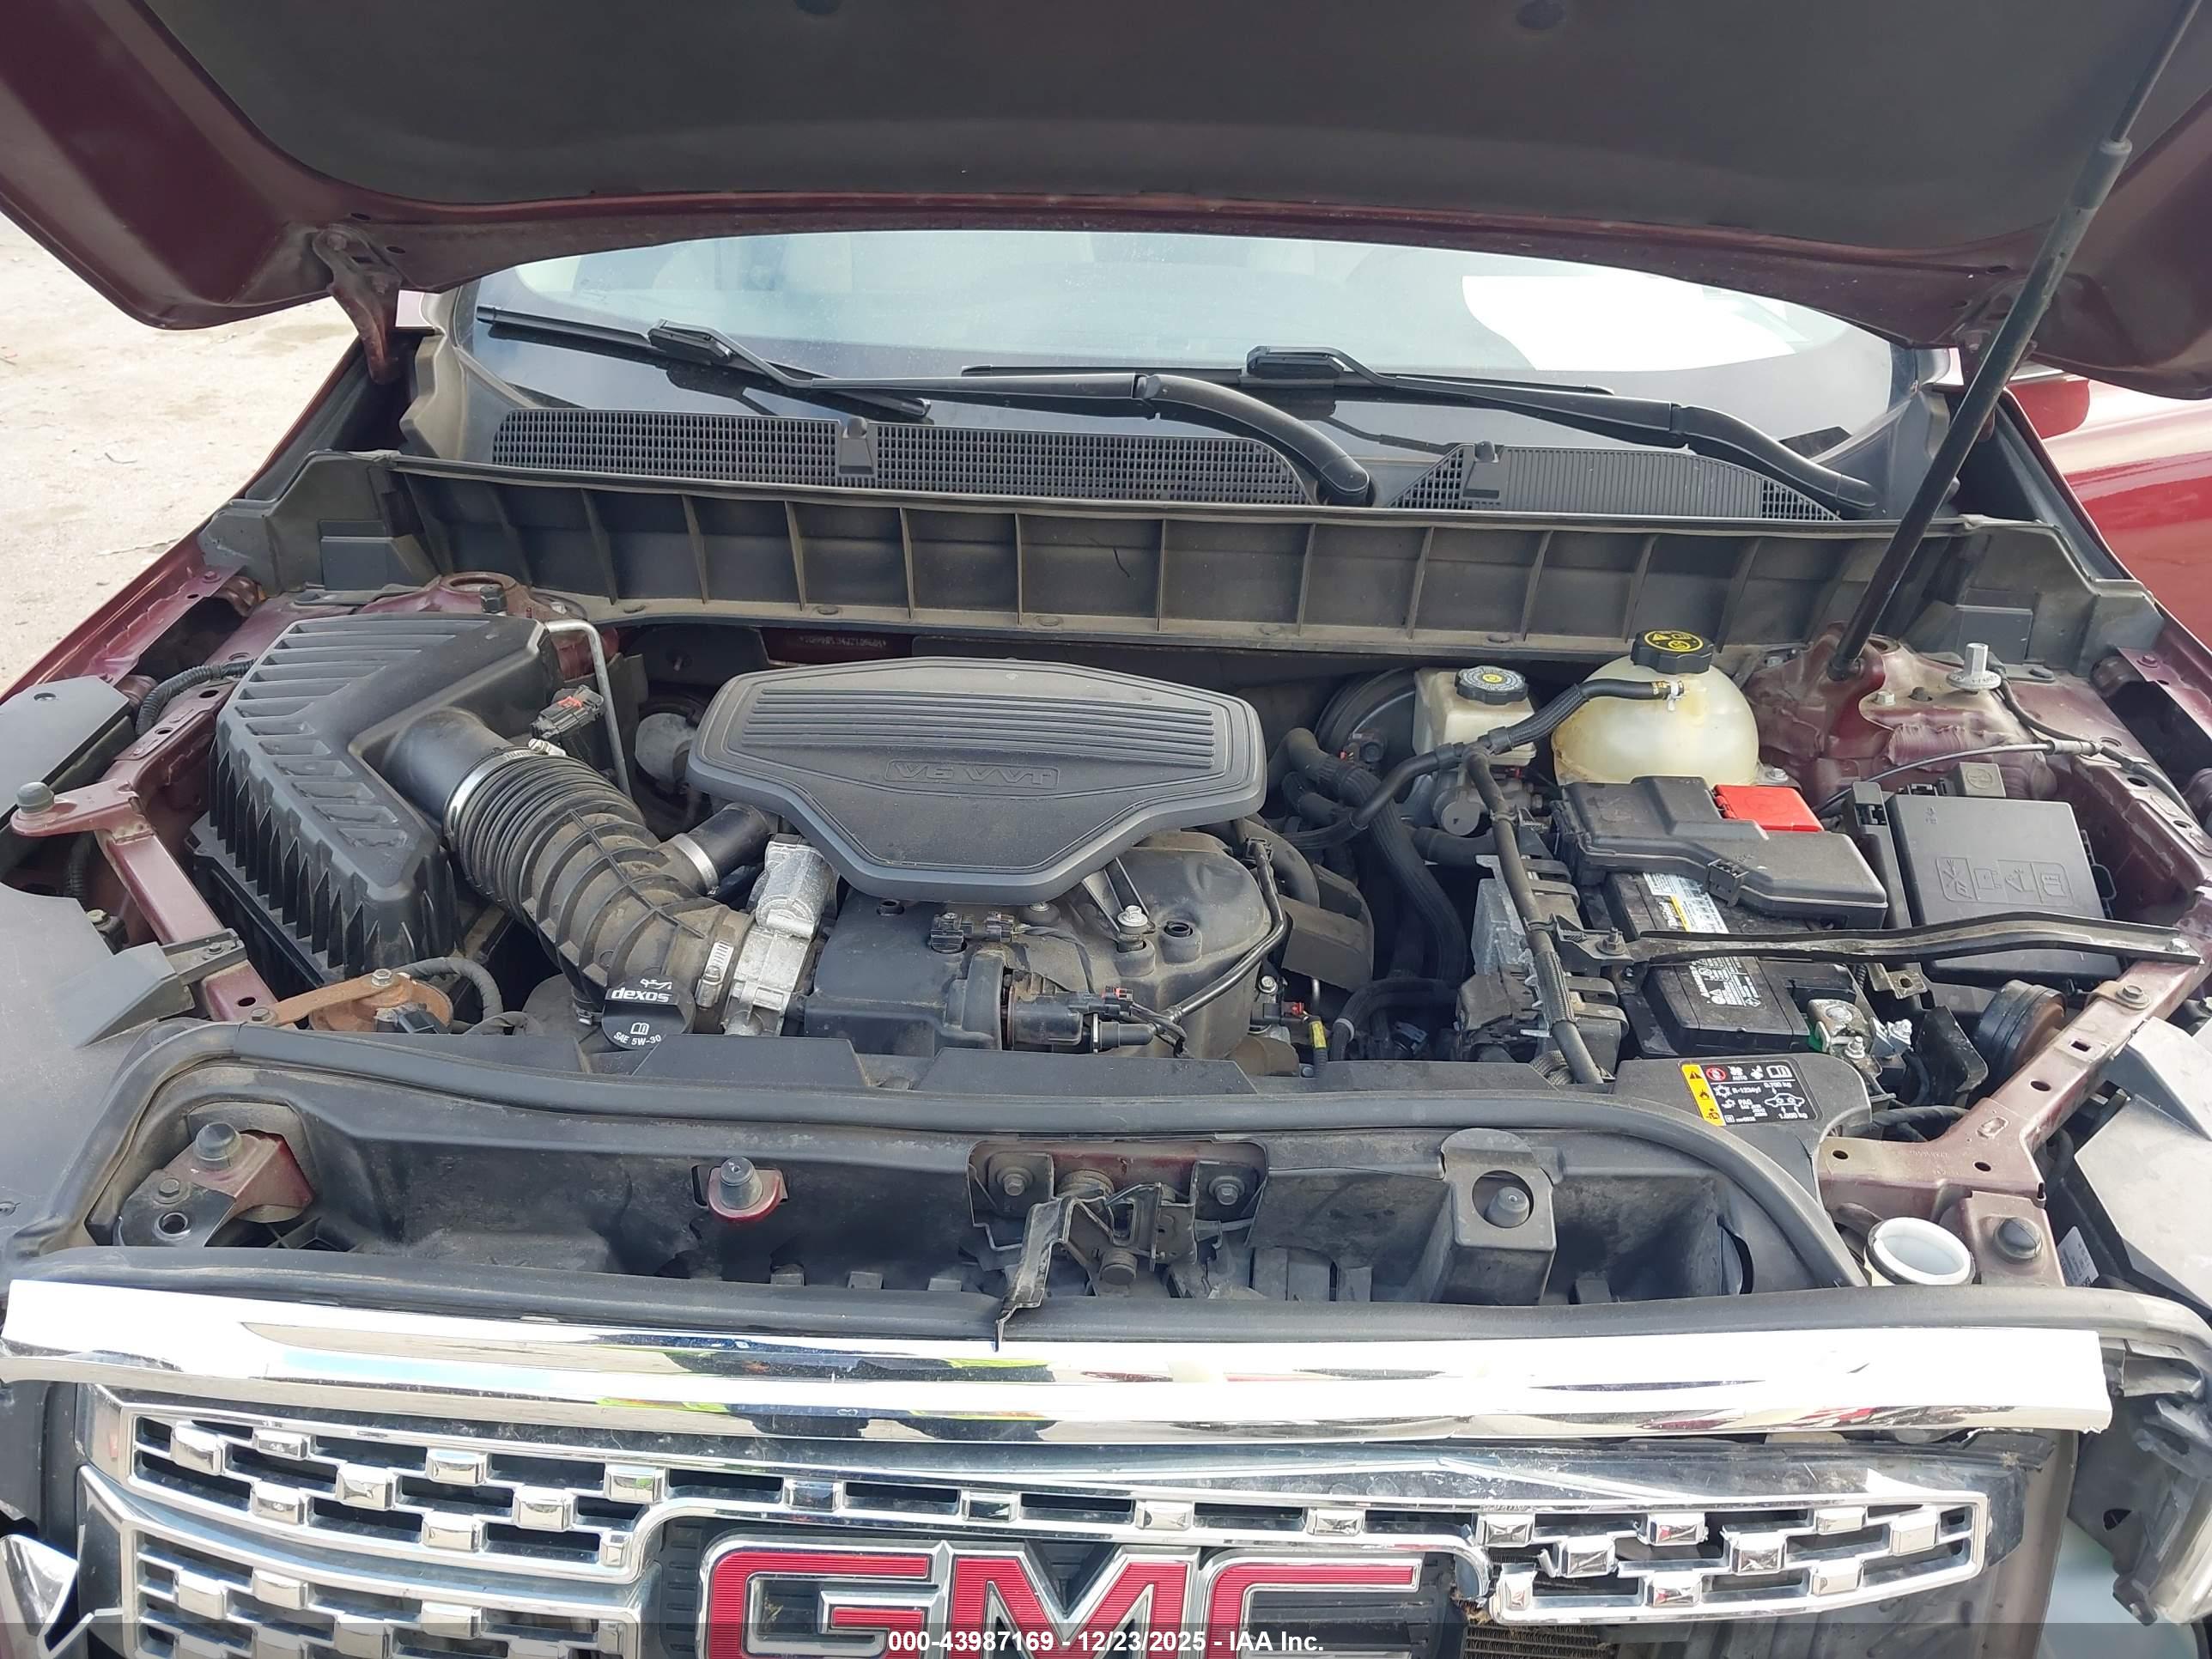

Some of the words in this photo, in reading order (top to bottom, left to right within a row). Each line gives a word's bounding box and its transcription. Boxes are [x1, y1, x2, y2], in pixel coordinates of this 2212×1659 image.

[894, 762, 954, 780] V6
[963, 767, 1052, 785] VVT
[611, 988, 672, 1003] dexos
[613, 1031, 630, 1044] SAE
[631, 1034, 661, 1046] 5W-30
[699, 1539, 1424, 1658] GMC
